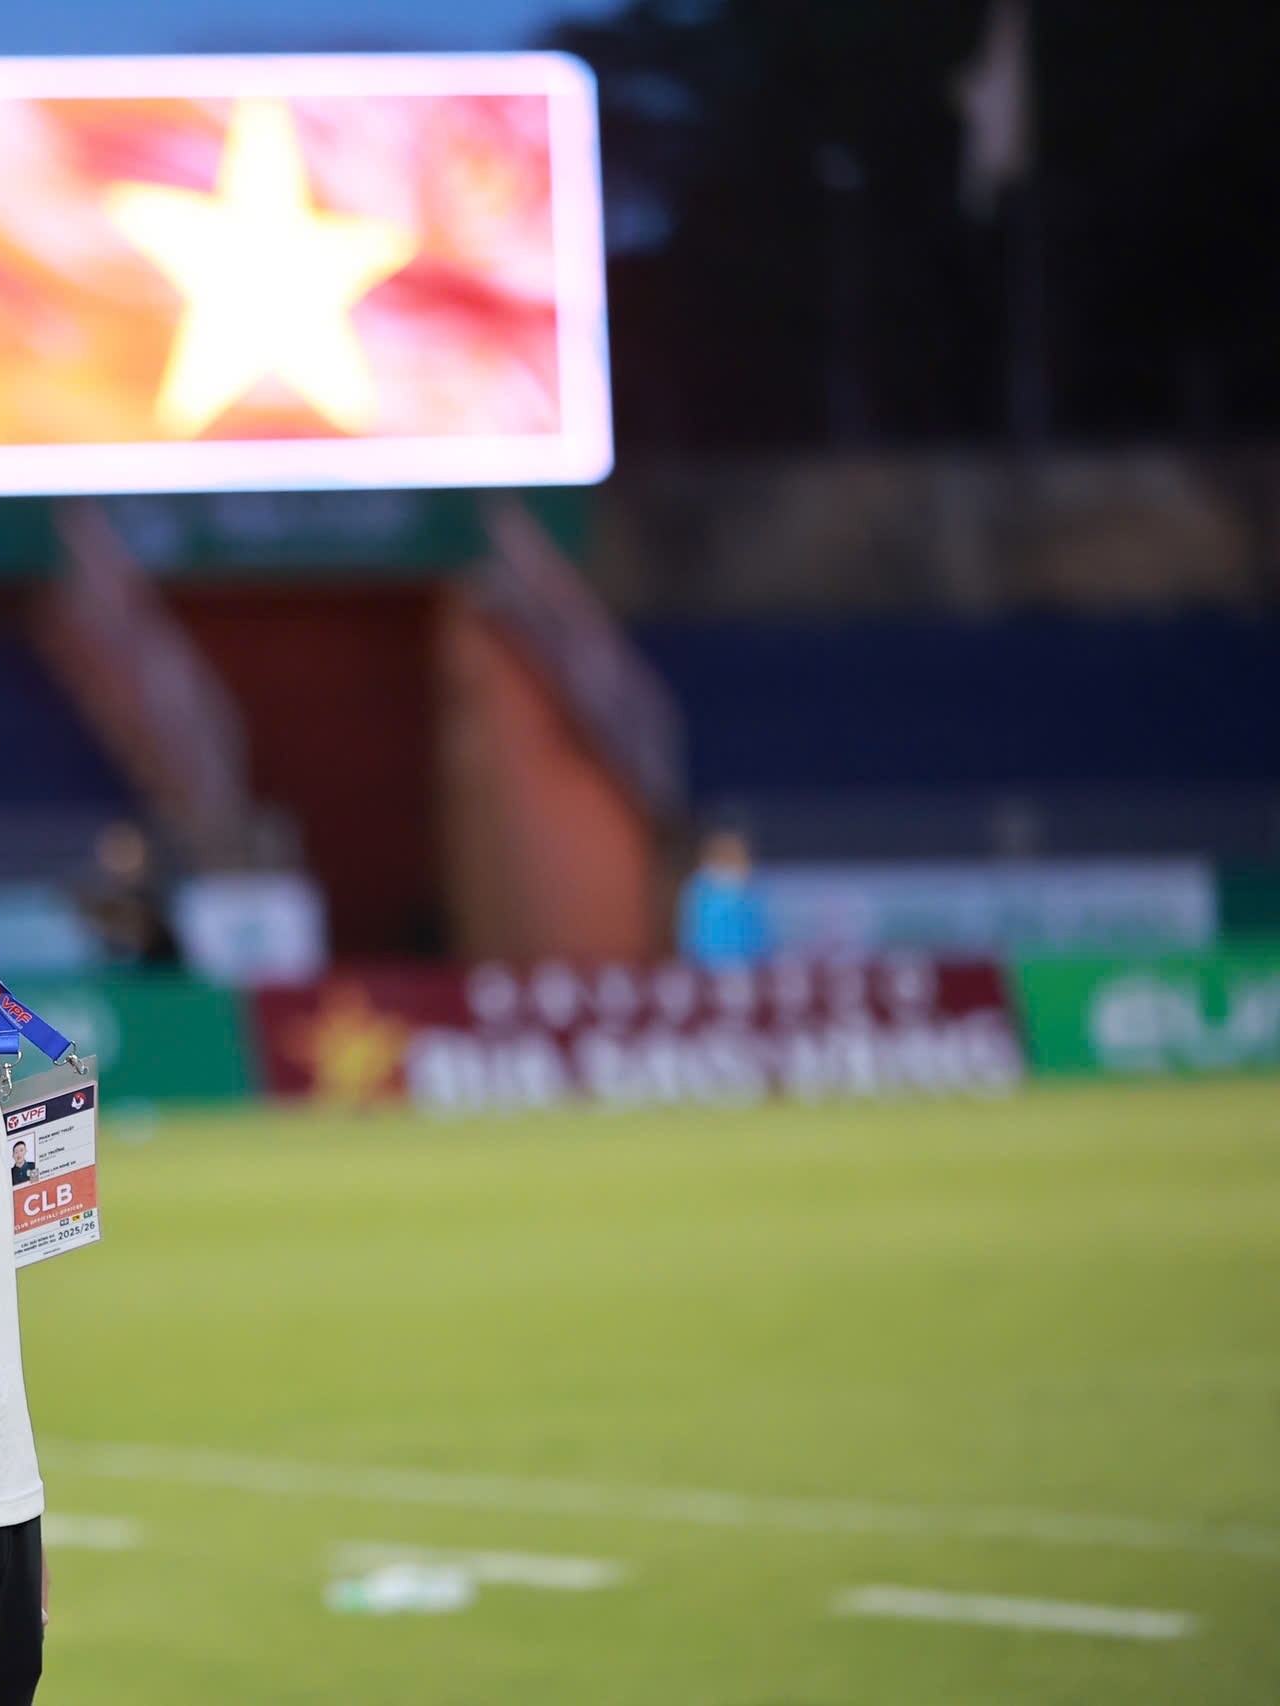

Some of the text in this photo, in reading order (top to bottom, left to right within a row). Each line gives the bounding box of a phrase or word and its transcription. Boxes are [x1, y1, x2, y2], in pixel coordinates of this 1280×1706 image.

[2, 995, 33, 1024] VPF
[21, 1107, 45, 1122] VPF
[23, 1183, 73, 1217] CLB
[58, 1221, 96, 1241] 2025/26
